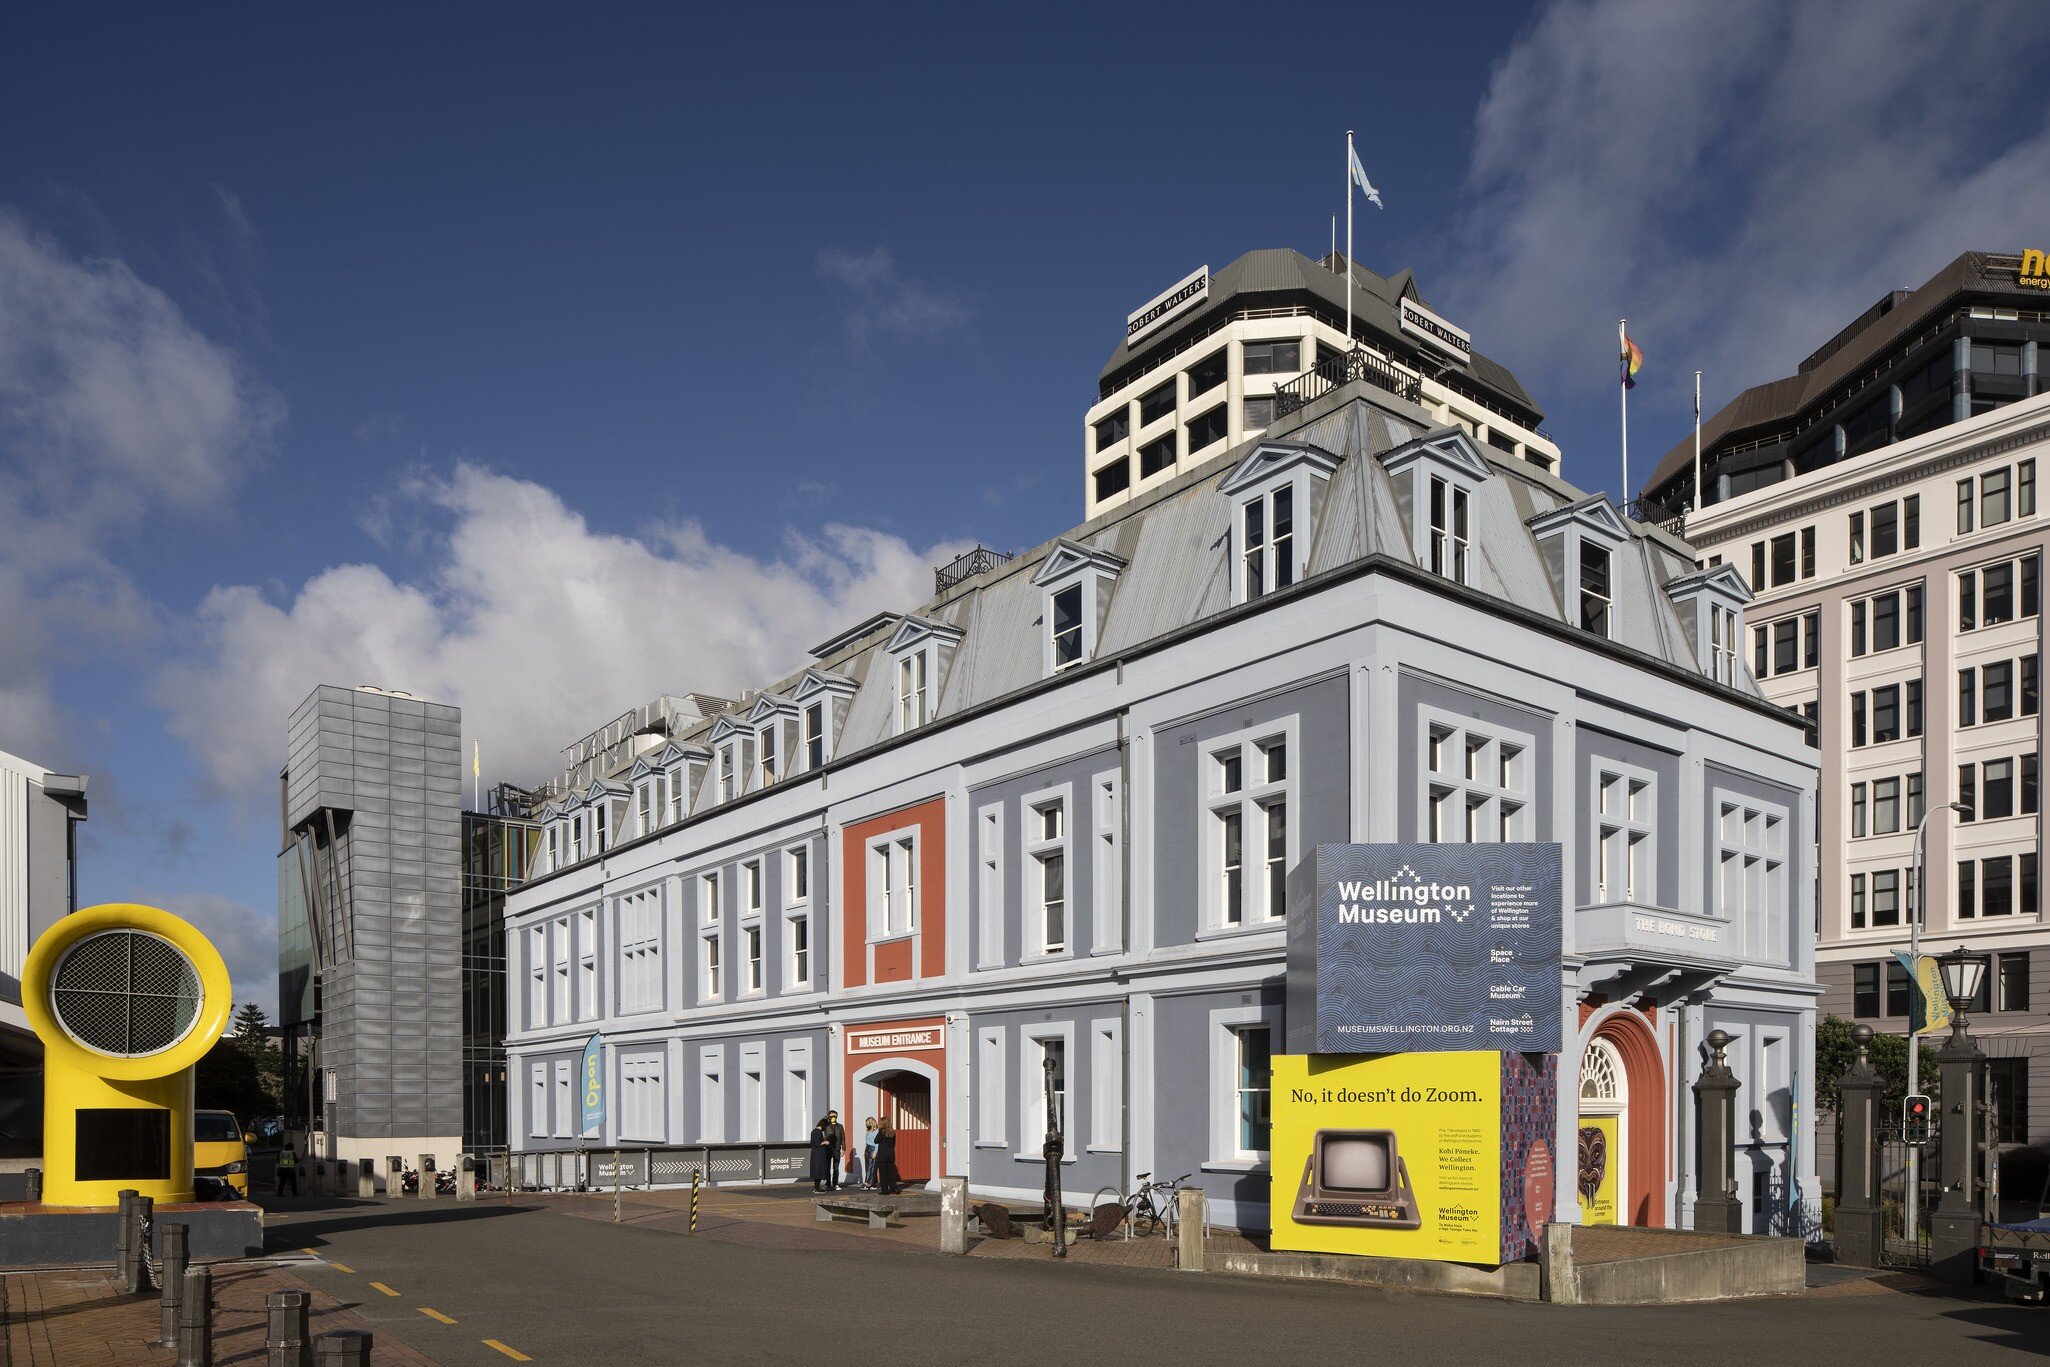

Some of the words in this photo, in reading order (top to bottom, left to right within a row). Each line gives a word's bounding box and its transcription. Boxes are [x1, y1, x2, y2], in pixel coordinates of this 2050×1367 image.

[1127, 307, 1160, 335] ROBERT
[1165, 276, 1206, 310] WALTERS
[1404, 308, 1434, 332] ROBERT
[1437, 328, 1471, 353] WALTERS
[1338, 880, 1471, 905] Wellington
[1338, 904, 1441, 923] Museum
[1635, 916, 1655, 933] THE
[1658, 921, 1685, 937] BOND
[1689, 926, 1718, 942] STORE
[1490, 949, 1513, 957] Space
[1930, 967, 1941, 1021] Wellington
[1337, 1025, 1474, 1033] MUSEUMSWELLINGTON.ORG.NZ
[1490, 1018, 1510, 1026] Nairn
[1511, 1018, 1534, 1026] Street
[1490, 1026, 1519, 1034] Cottage
[859, 1035, 890, 1048] MUSEUM
[892, 1032, 932, 1046] ENTRANCE
[586, 1053, 601, 1107] Open
[1291, 1089, 1318, 1105] No,
[1321, 1088, 1333, 1103] it
[1400, 1087, 1422, 1102] do
[1425, 1088, 1484, 1103] Zoom.
[599, 1163, 634, 1171] Welligton
[1438, 1164, 1477, 1172] Wellington.
[1438, 1207, 1478, 1216] Wellington
[1438, 1214, 1470, 1222] Museum
